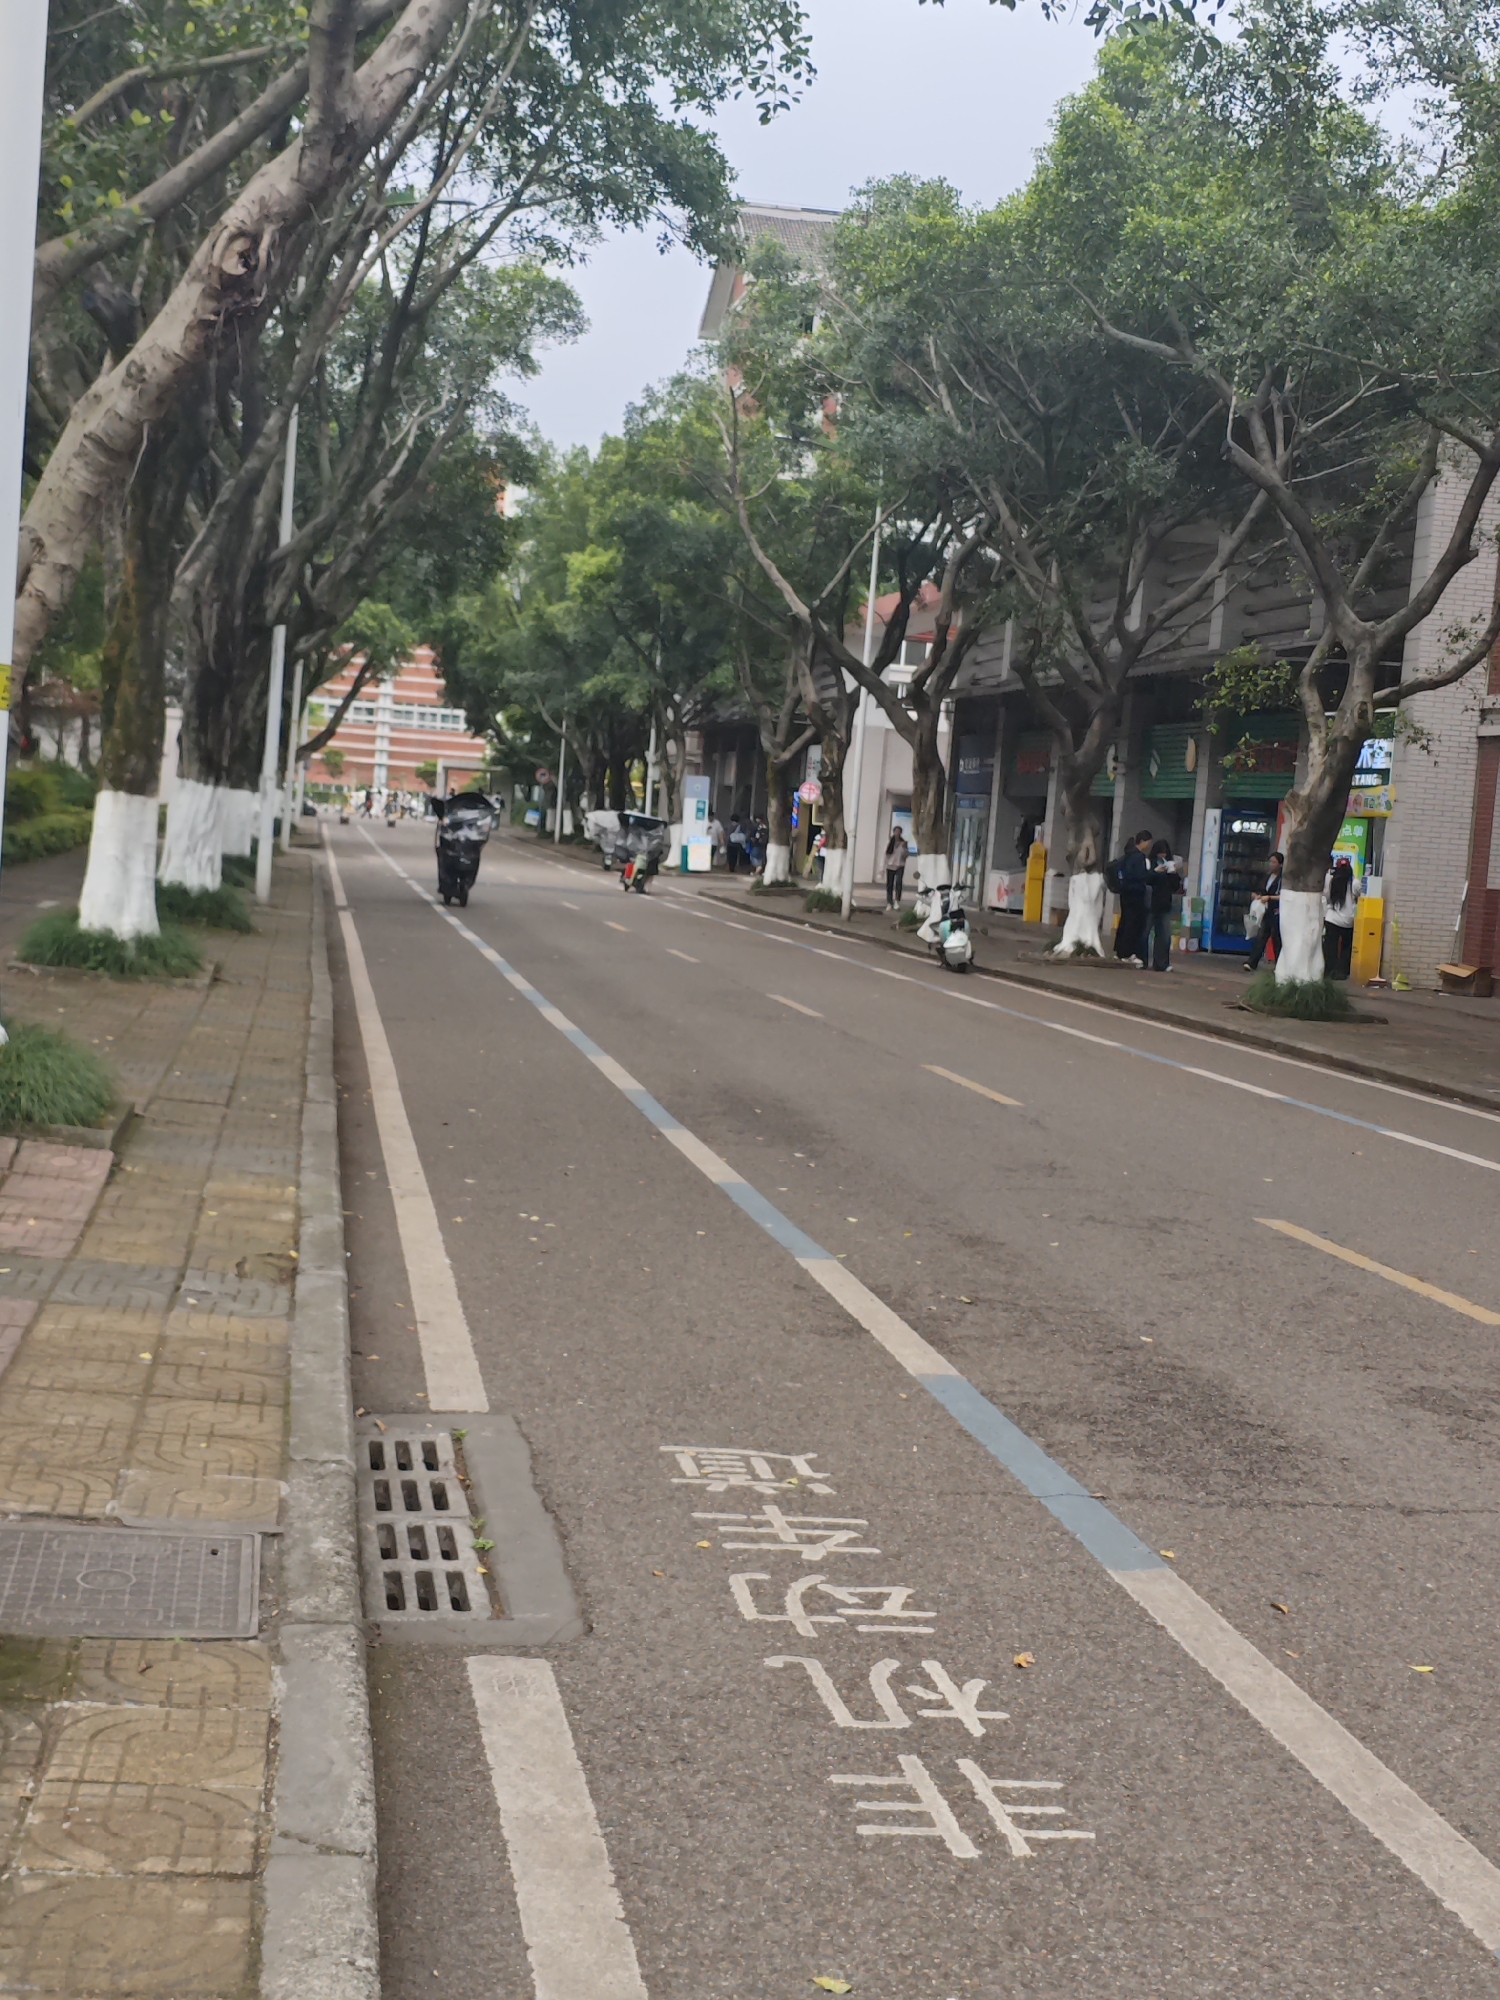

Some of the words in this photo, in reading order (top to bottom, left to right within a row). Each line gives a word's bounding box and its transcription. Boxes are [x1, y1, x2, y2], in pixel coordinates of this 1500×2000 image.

[1352, 773, 1382, 786] TANG
[659, 1445, 1096, 1858] 非机动车道
